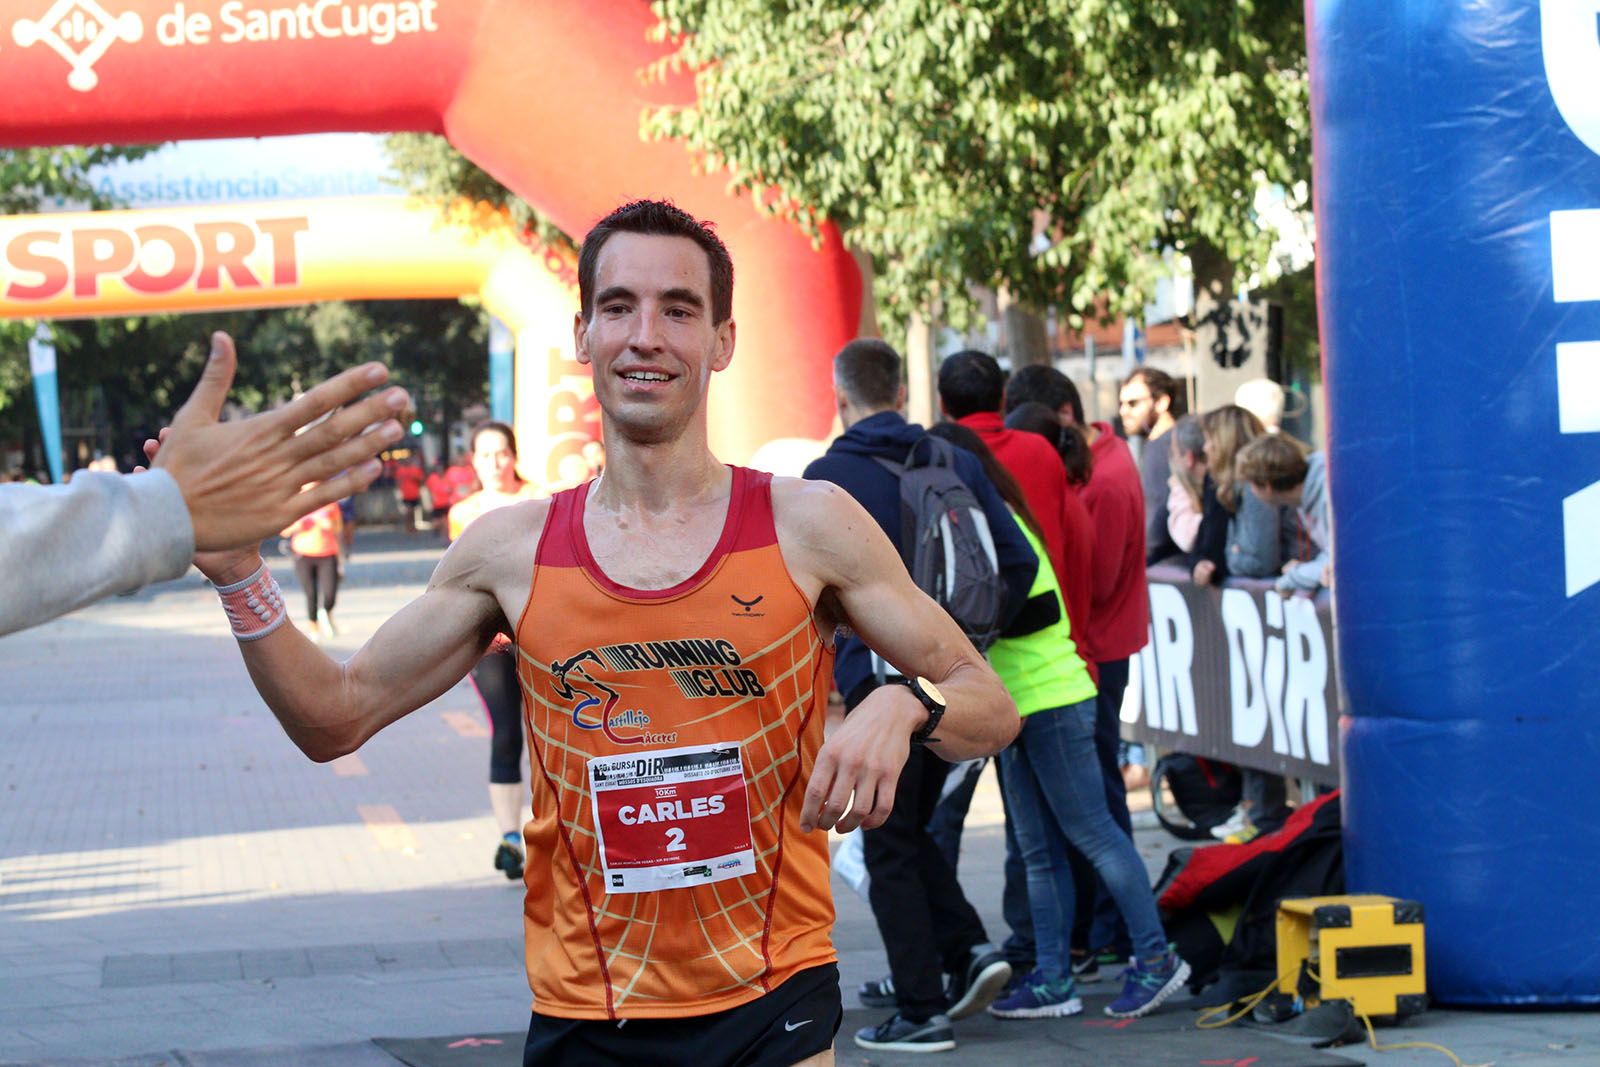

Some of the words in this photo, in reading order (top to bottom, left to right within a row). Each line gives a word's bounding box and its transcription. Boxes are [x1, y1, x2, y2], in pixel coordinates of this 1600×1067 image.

[157, 2, 211, 46] de
[220, 0, 438, 45] SantCugat
[6, 216, 309, 301] SPORT
[617, 639, 742, 672] RUNNING
[690, 668, 766, 699] CLUB
[1221, 588, 1329, 767] DiR
[636, 757, 663, 777] DiR
[618, 795, 726, 825] CARLES
[664, 826, 687, 853] 2
